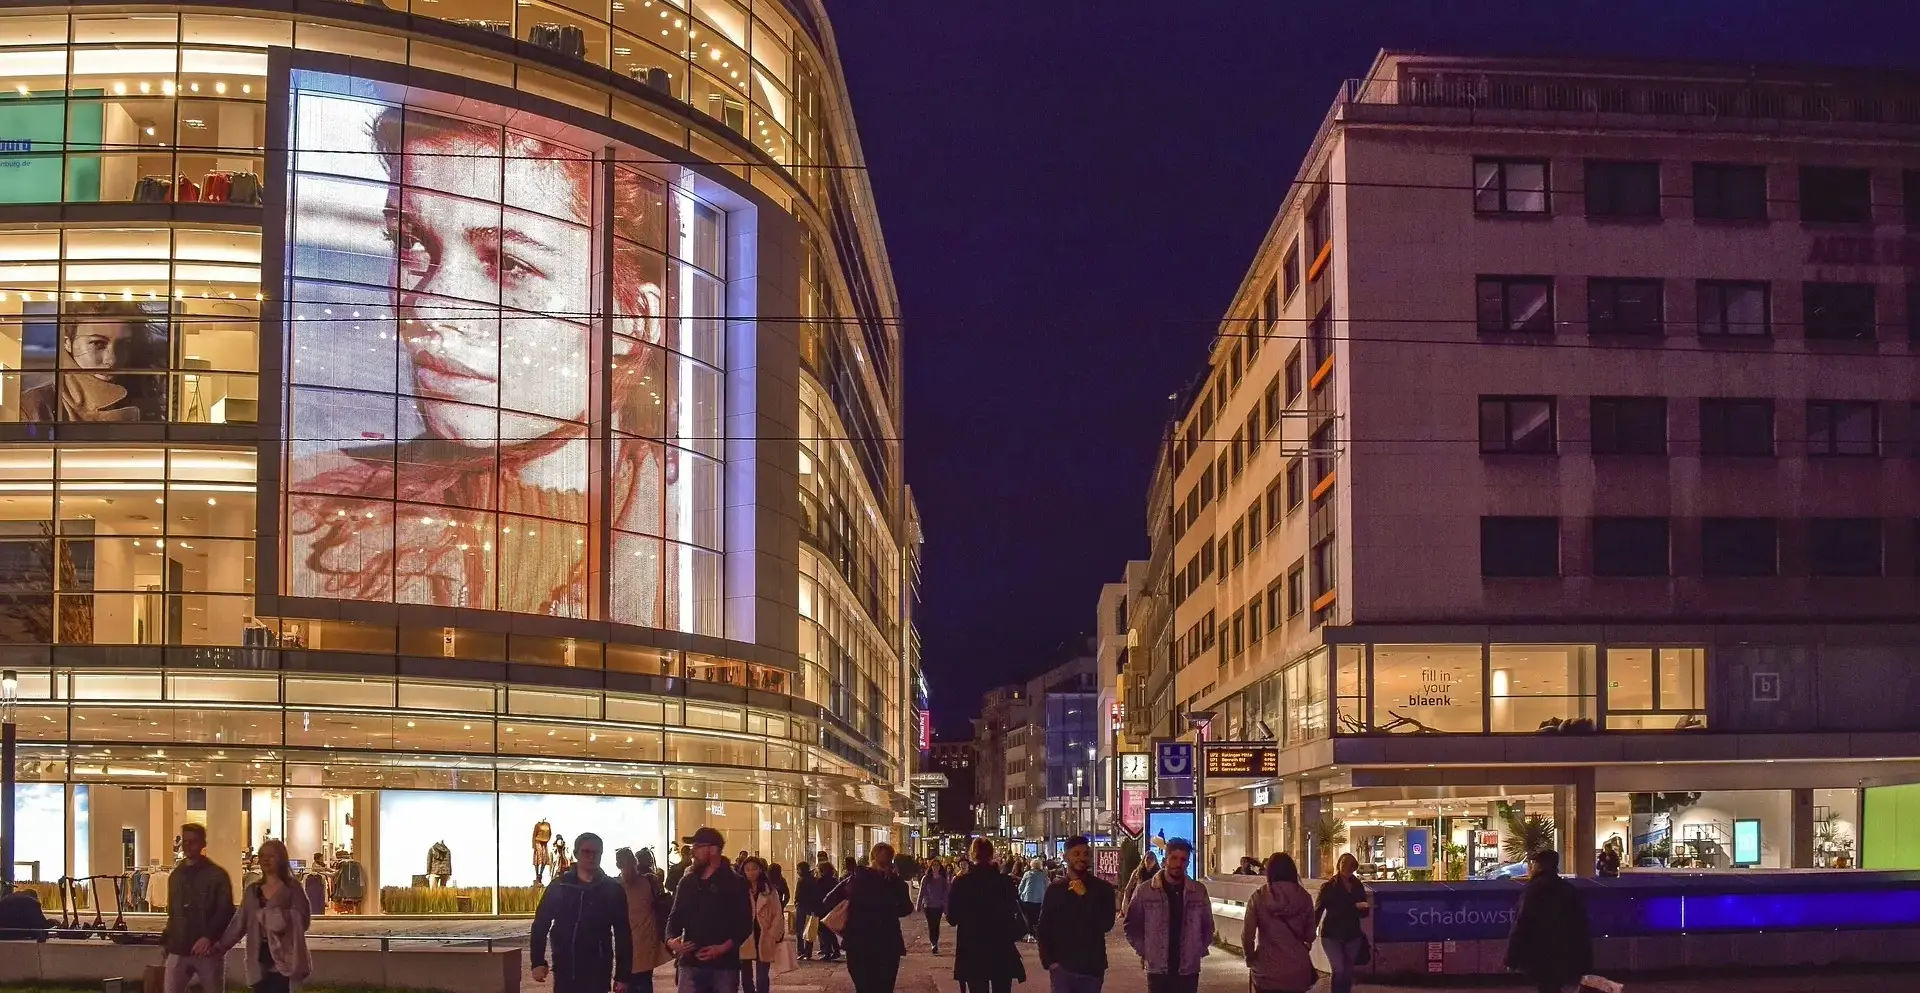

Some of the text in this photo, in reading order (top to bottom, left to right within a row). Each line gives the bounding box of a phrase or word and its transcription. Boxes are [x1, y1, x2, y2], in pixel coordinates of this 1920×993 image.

[1422, 670, 1451, 682] fill in
[1424, 684, 1451, 696] your
[1164, 746, 1187, 773] U
[1100, 851, 1118, 859] LACH
[1099, 866, 1118, 874] MAL
